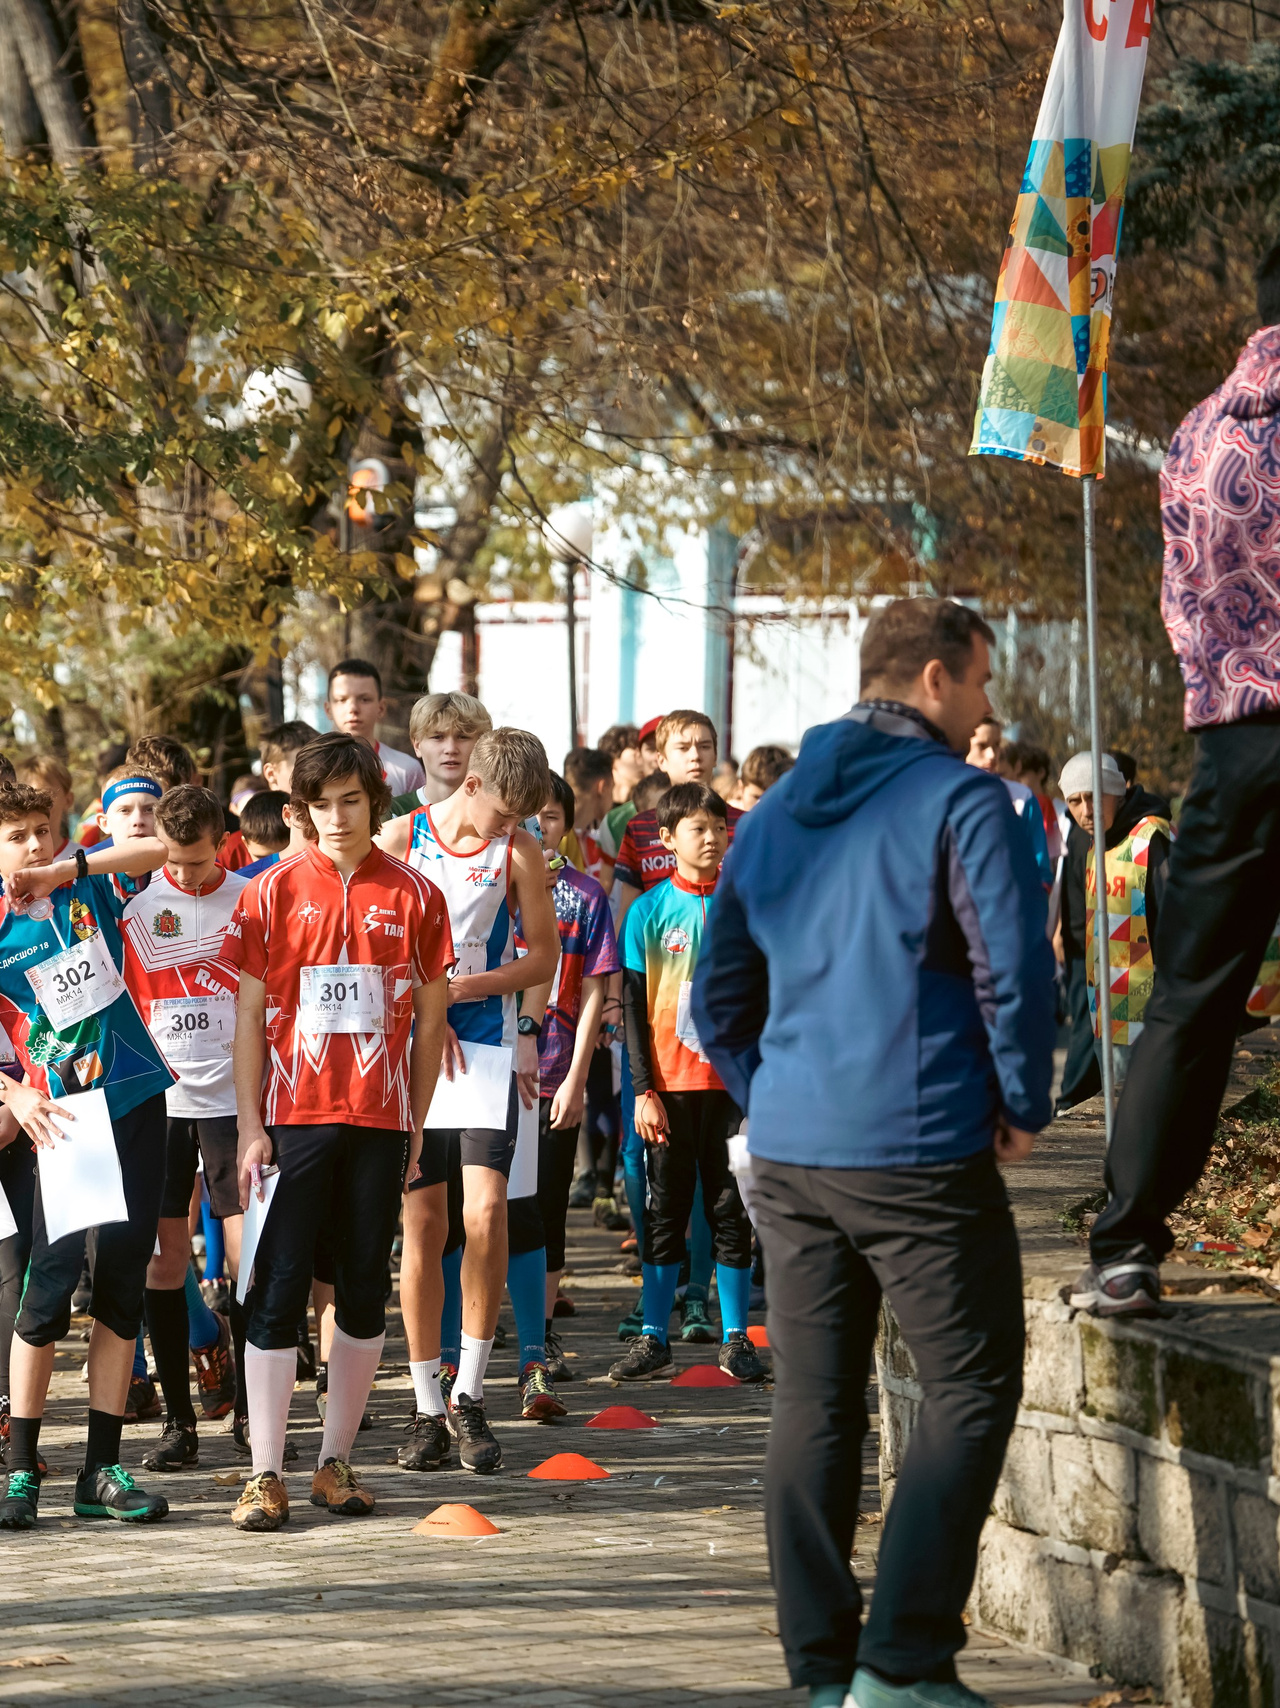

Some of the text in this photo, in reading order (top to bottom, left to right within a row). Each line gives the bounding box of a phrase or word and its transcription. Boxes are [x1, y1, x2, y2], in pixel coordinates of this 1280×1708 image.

[114, 782, 155, 793] noname
[383, 922, 405, 938] TAR
[39, 941, 50, 951] 18
[101, 960, 108, 971] 1
[467, 965, 472, 975] 1
[53, 960, 96, 993] 302
[56, 987, 83, 1005] МЖ14
[320, 982, 359, 1002] 301
[368, 992, 374, 1003] 1
[315, 1003, 342, 1011] МЖ14
[171, 1012, 209, 1032] 308
[217, 1019, 223, 1030] 1
[167, 1032, 192, 1040] МЖ14
[75, 1058, 90, 1071] 18
